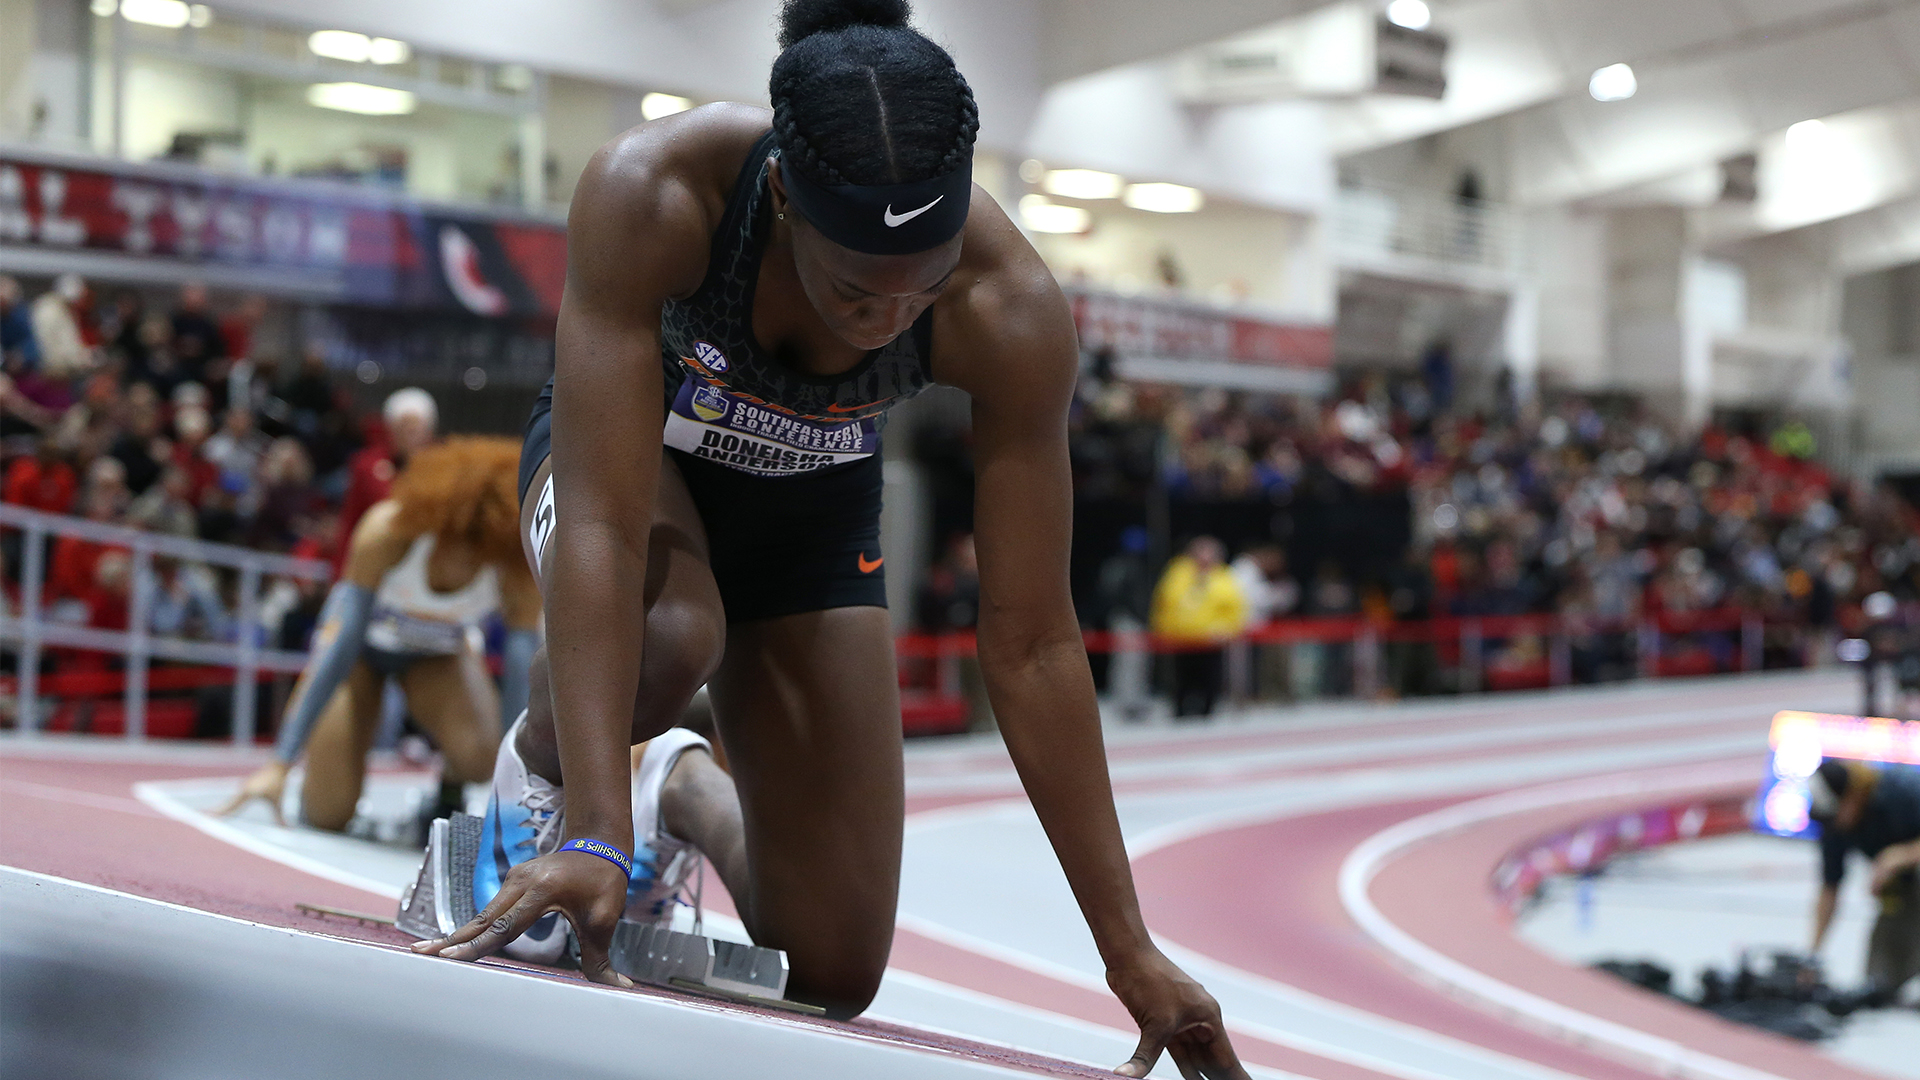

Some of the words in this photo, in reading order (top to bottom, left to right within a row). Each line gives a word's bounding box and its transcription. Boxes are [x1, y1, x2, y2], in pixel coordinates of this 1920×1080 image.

[695, 342, 727, 371] SEC
[732, 414, 863, 449] CONFERENCE
[735, 402, 863, 441] SOUTHEASTERN
[757, 430, 779, 441] TRACK
[701, 429, 835, 464] DONEISHA
[535, 484, 553, 557] 5
